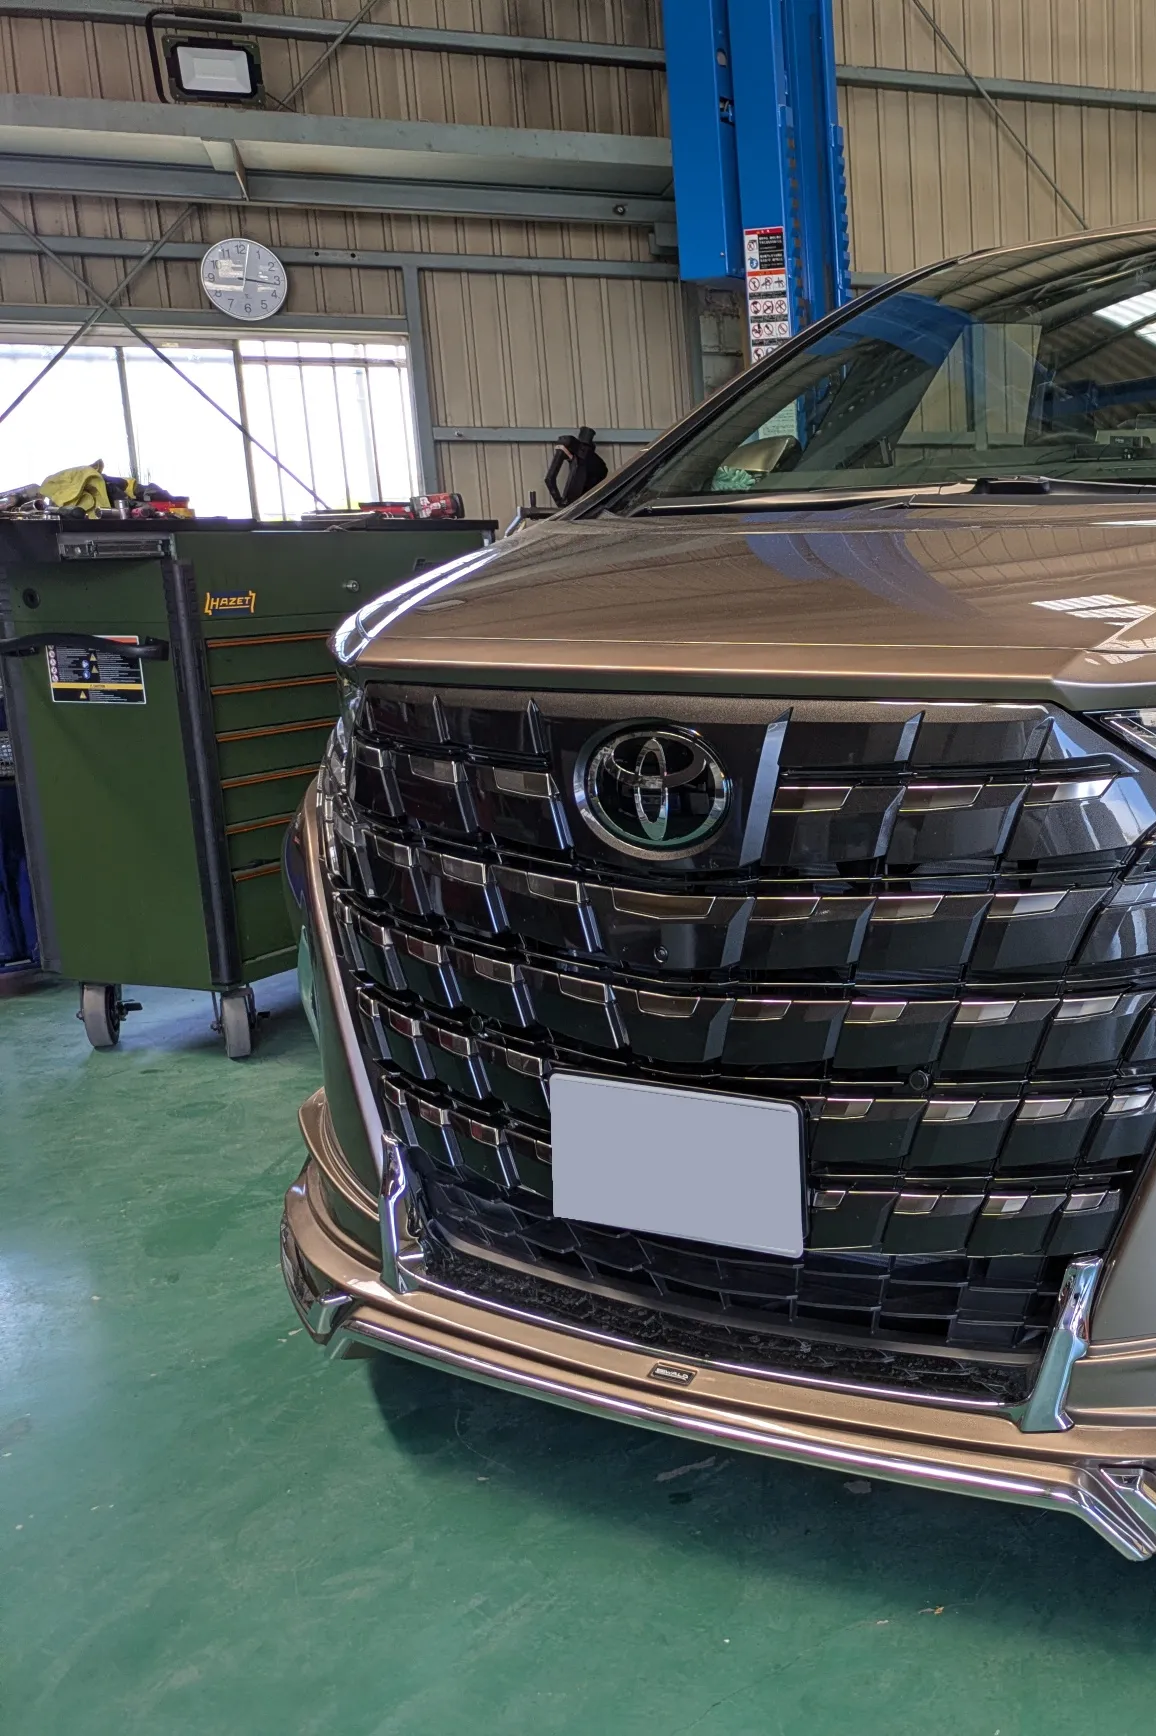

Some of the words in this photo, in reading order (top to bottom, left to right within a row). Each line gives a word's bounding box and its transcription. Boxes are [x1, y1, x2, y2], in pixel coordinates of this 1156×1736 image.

[221, 248, 231, 259] 11
[234, 244, 246, 255] 12
[256, 250, 261, 260] 1
[267, 261, 275, 272] 2
[207, 272, 215, 283] 9
[273, 275, 280, 286] 3
[271, 289, 278, 298] 4
[227, 298, 235, 309] 7
[244, 303, 252, 313] 6
[260, 299, 268, 310] 5
[209, 596, 252, 610] HAZET
